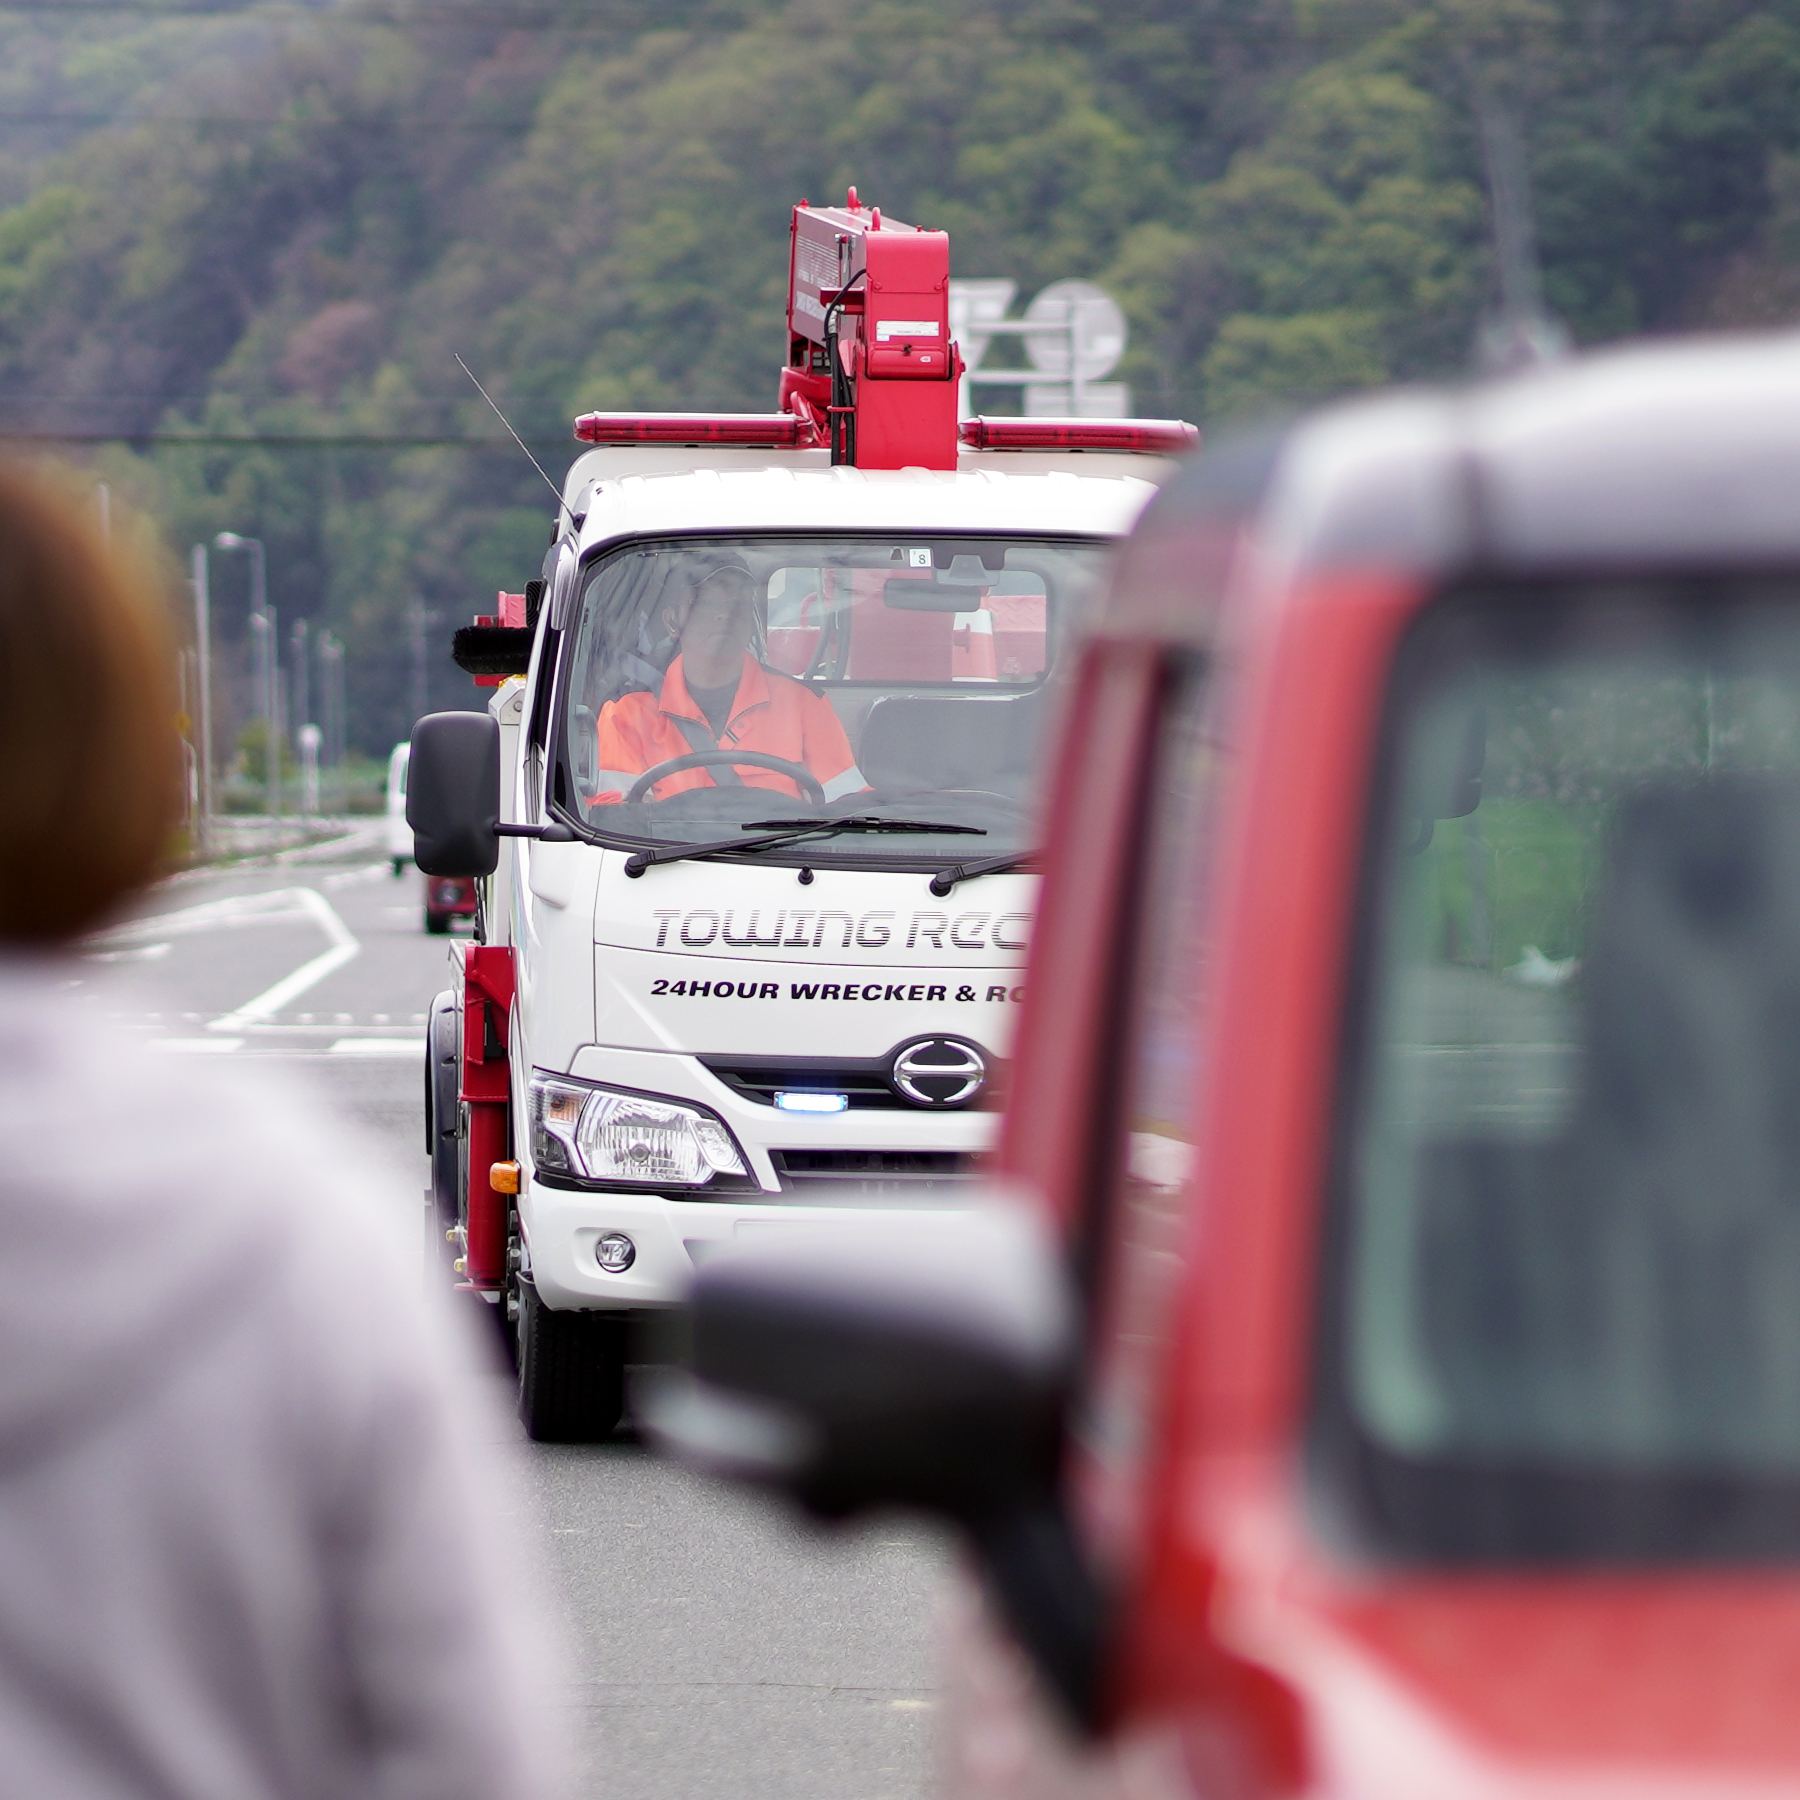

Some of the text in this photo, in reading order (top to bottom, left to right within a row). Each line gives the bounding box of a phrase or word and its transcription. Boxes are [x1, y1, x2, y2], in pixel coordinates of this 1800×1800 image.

[652, 909, 897, 948] TOWING
[651, 978, 780, 999] 24HOUR
[790, 983, 948, 1001] WRECKER
[955, 985, 977, 1002] &
